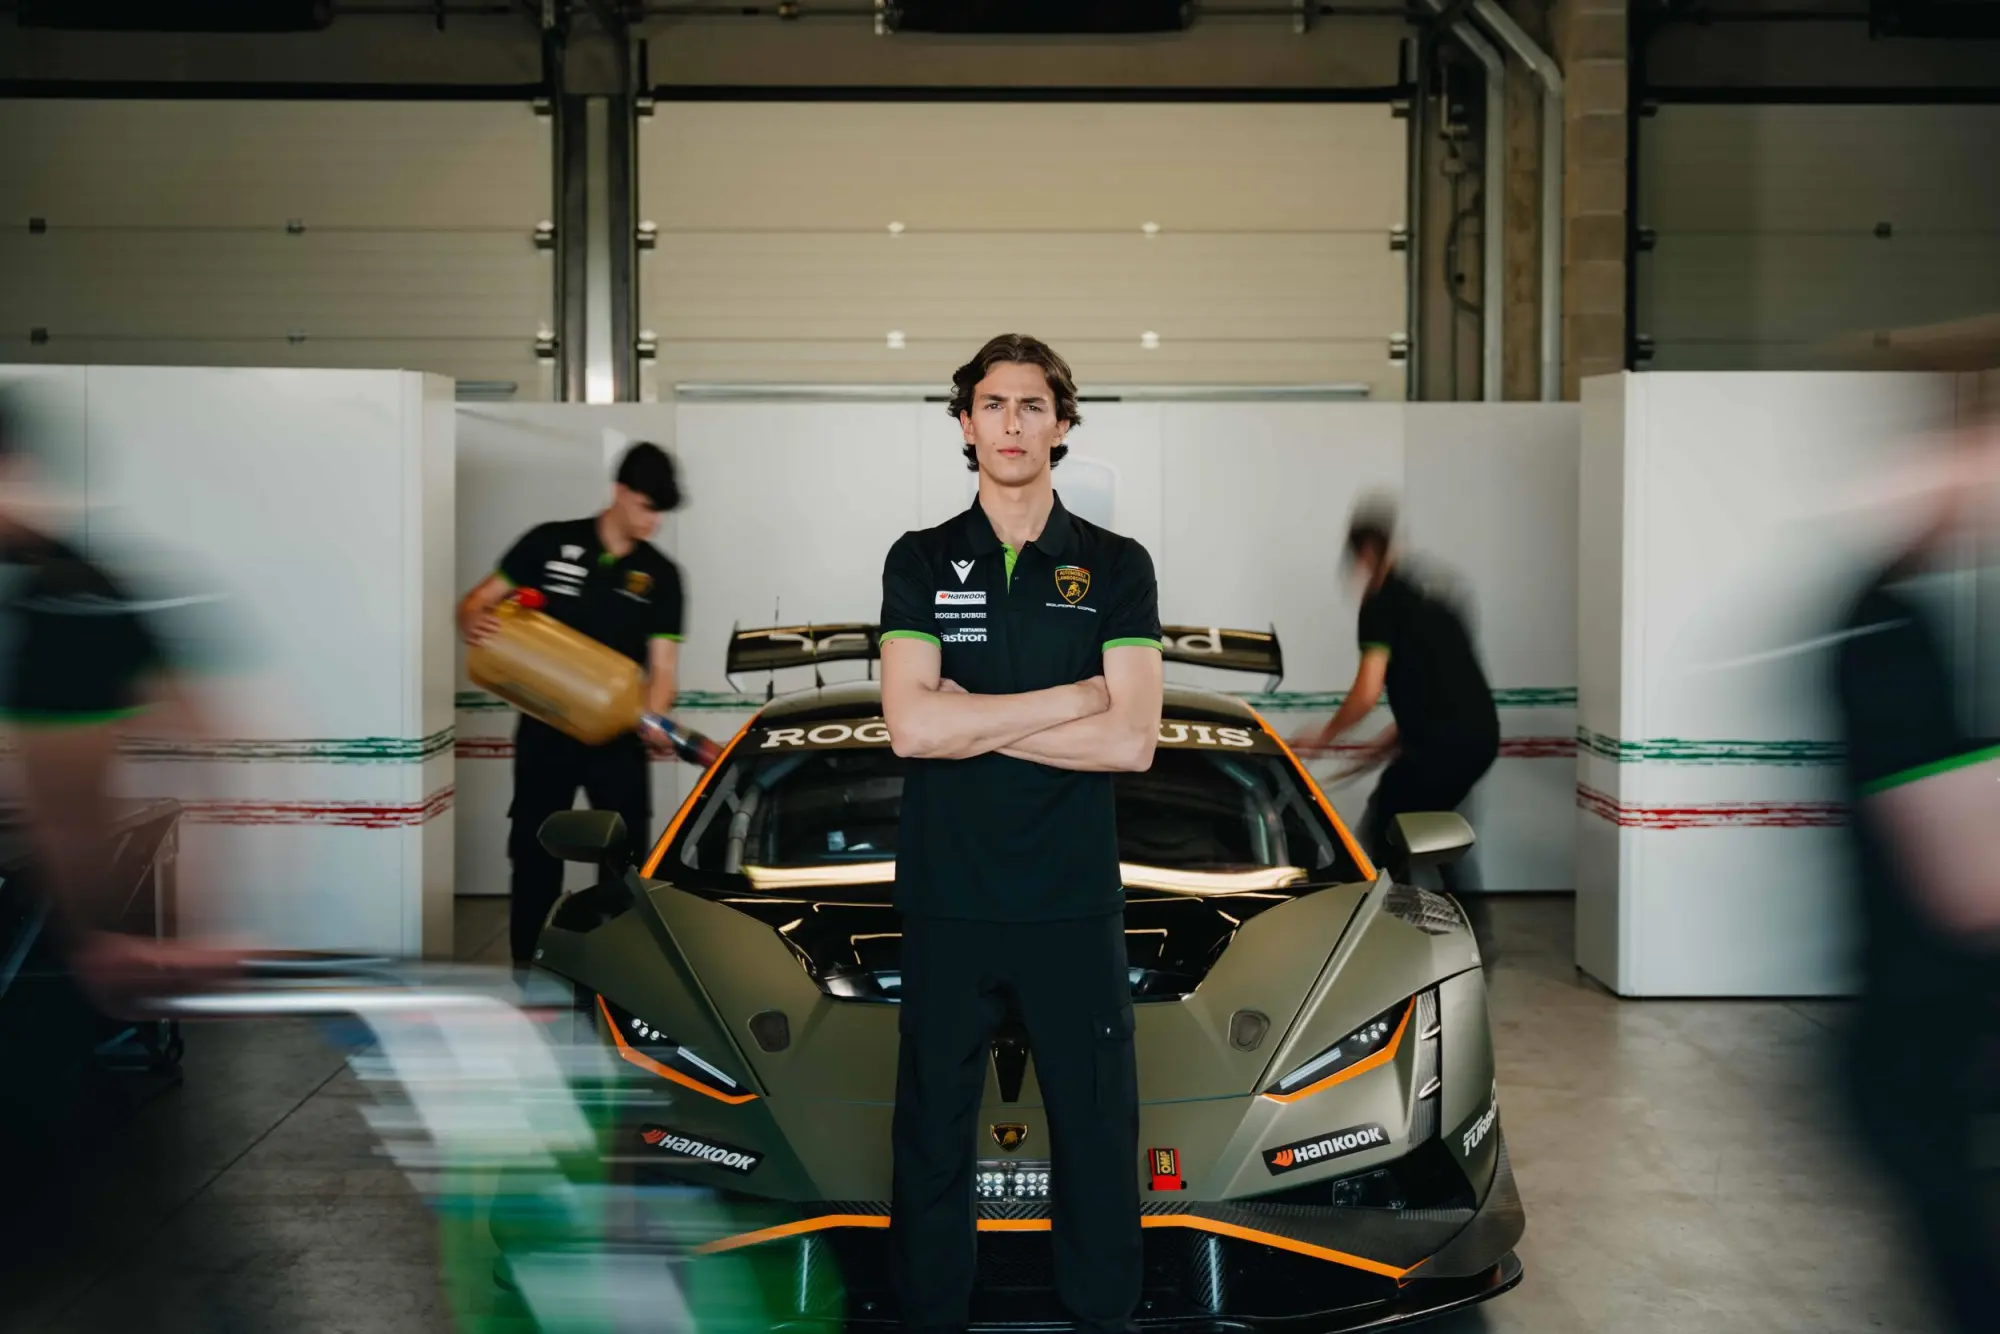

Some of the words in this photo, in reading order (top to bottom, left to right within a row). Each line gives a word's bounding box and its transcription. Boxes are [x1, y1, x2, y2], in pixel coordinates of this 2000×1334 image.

[942, 633, 987, 642] astron
[760, 722, 892, 748] ROG
[1158, 723, 1254, 747] UIS
[1159, 1151, 1172, 1174] OMP
